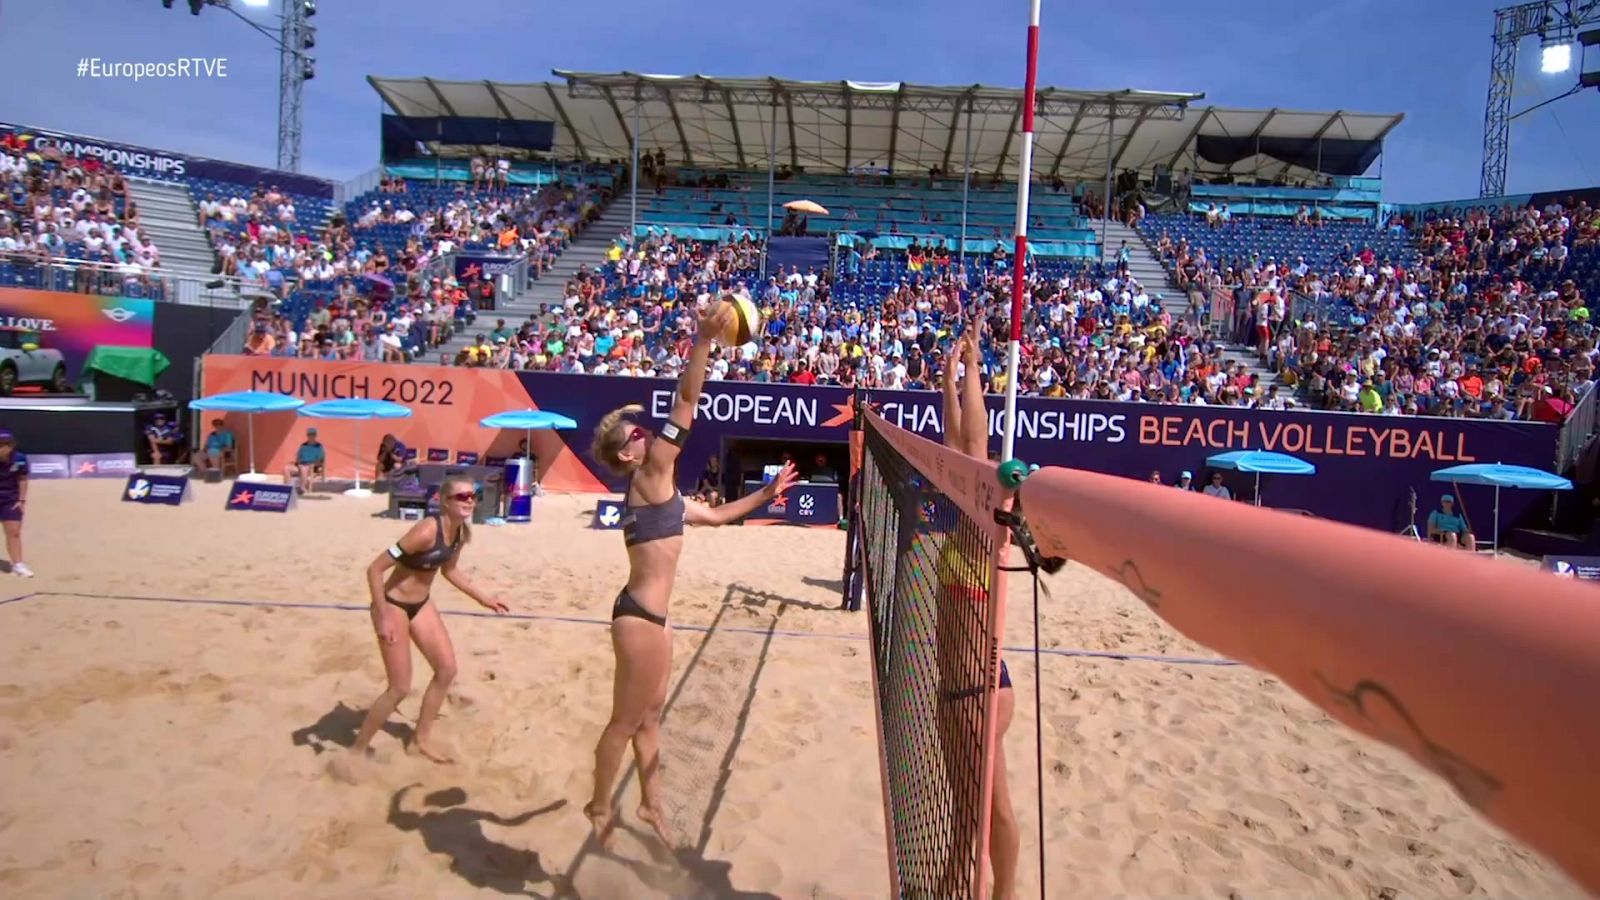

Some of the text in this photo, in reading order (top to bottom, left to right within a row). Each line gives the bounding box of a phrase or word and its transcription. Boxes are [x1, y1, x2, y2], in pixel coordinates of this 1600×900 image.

[8, 316, 57, 331] LOVE.
[252, 370, 454, 405] MUNICH 2022
[651, 390, 1475, 461] EROPEAN CHAIONSHIPS BEACH VOLLEYBALL
